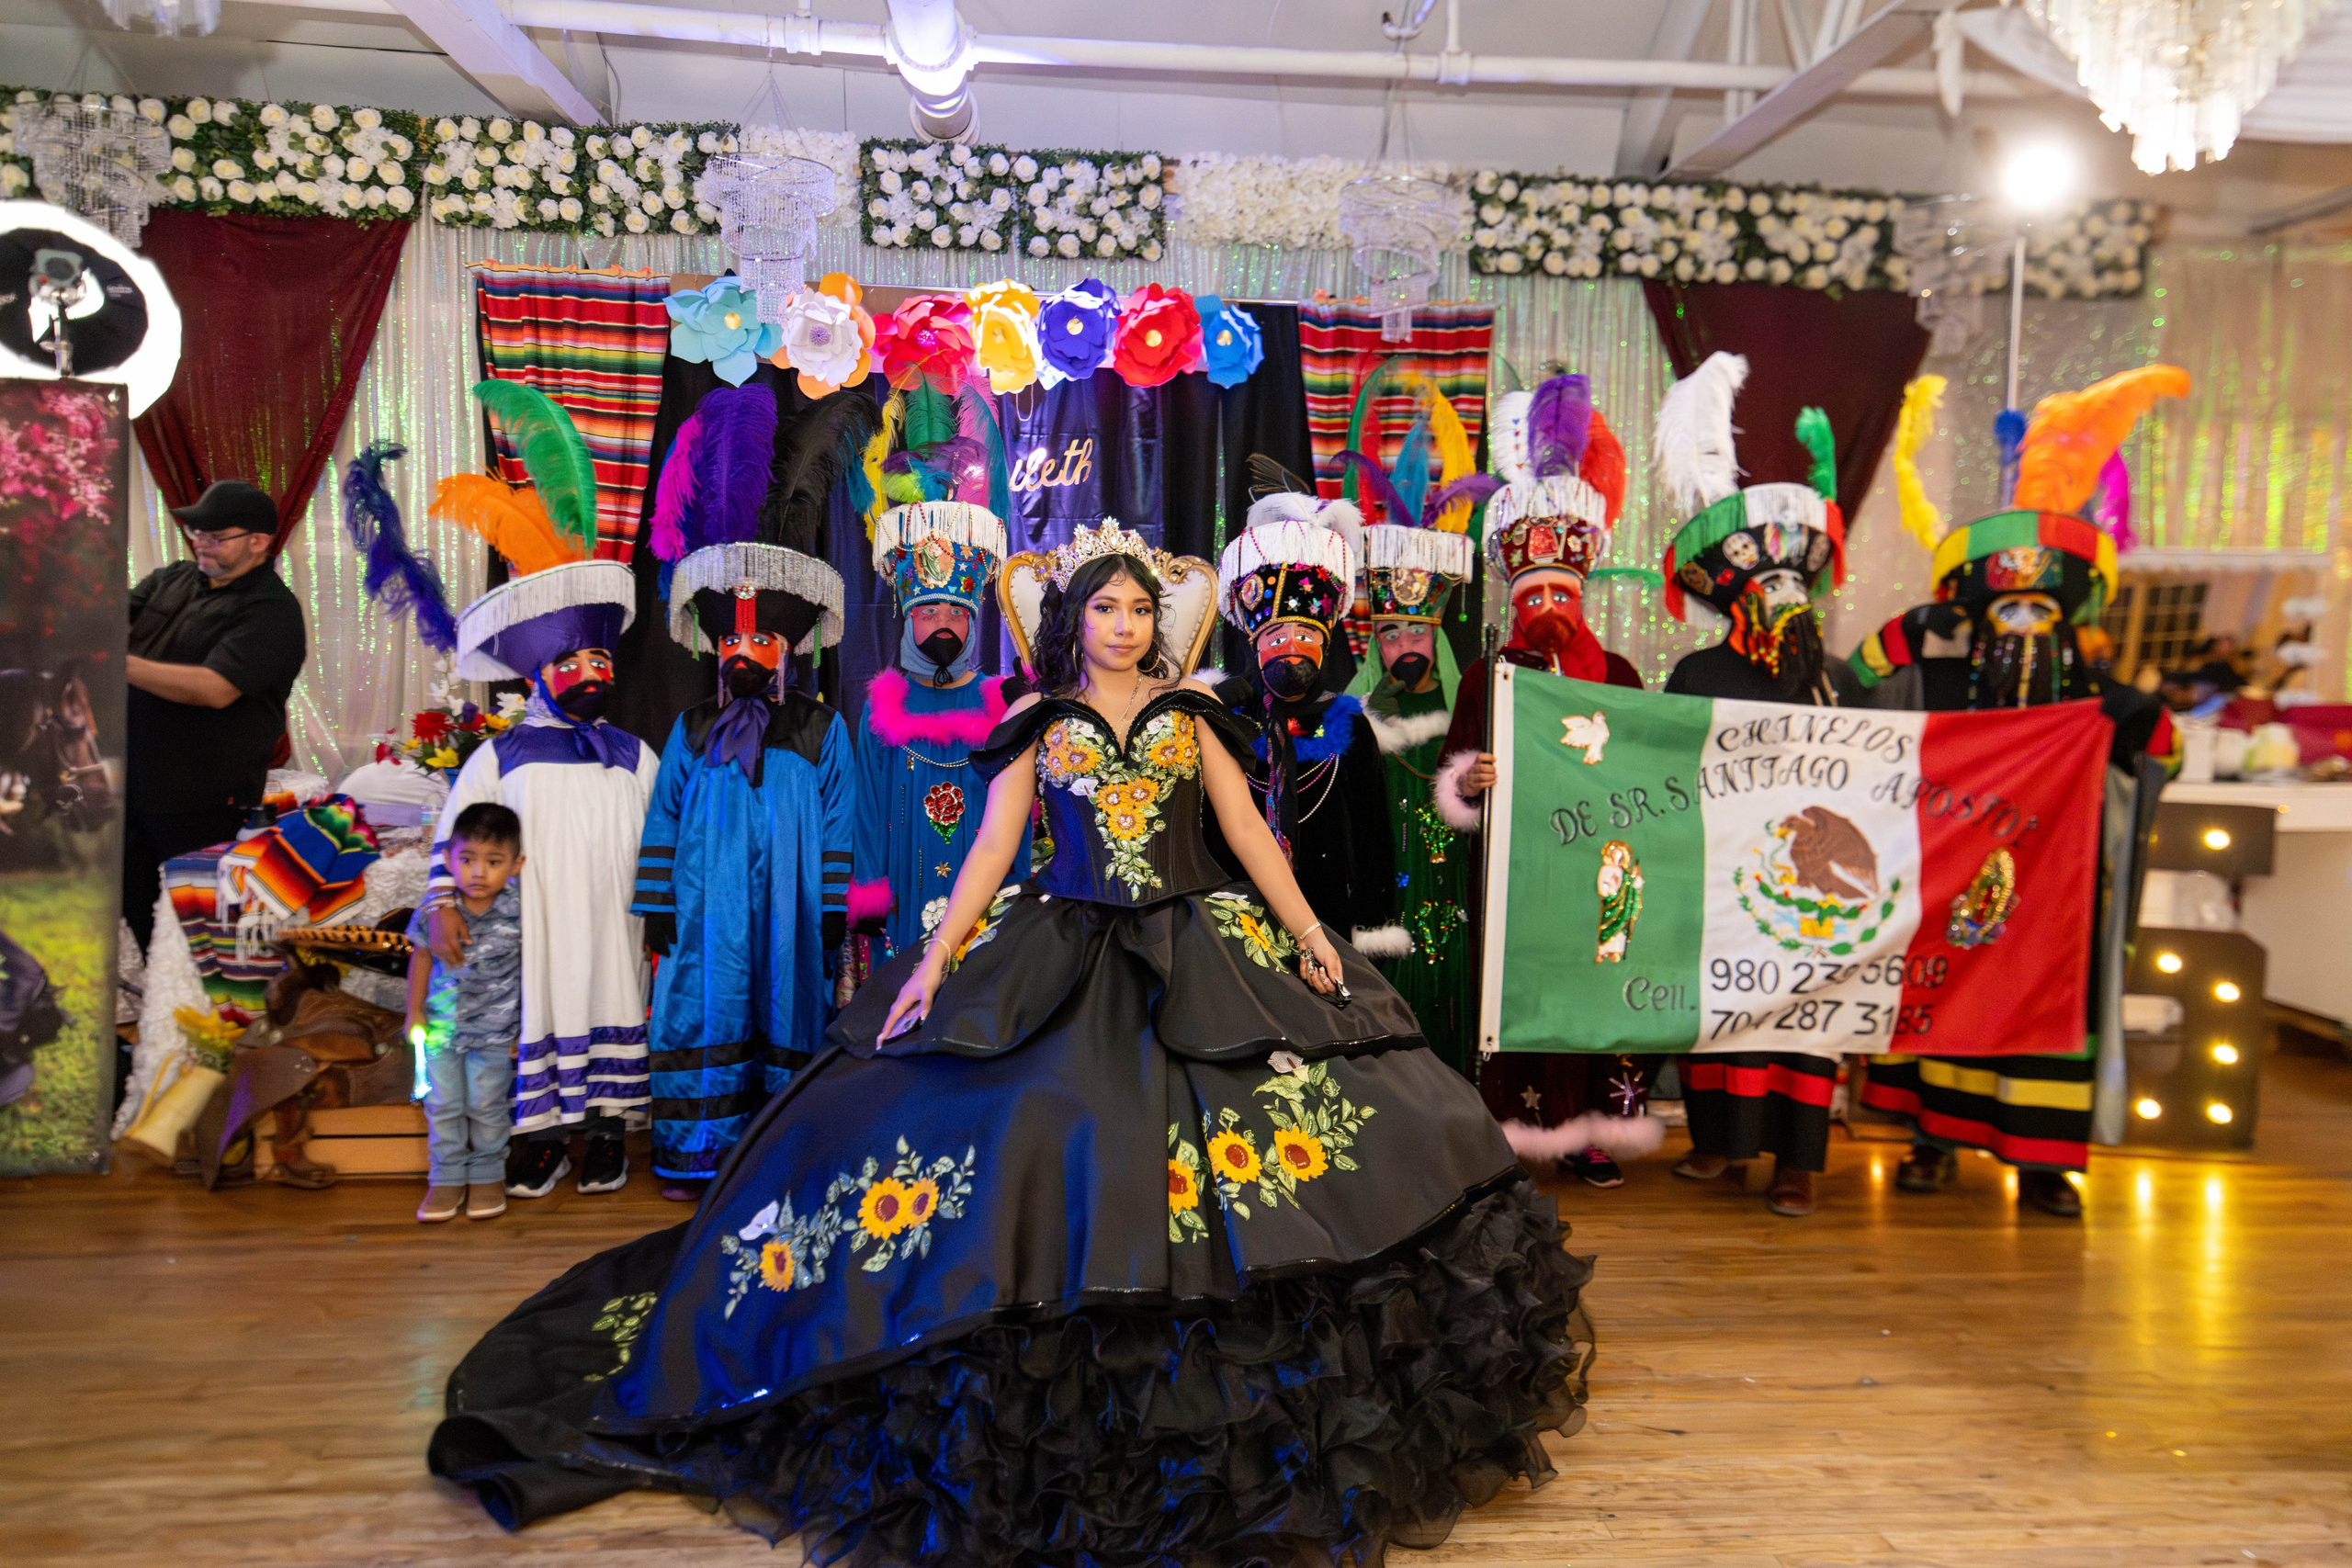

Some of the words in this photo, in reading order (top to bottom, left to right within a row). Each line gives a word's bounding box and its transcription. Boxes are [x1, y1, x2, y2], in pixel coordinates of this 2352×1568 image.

[1716, 714, 1913, 763] CHINELOS
[1549, 801, 1598, 845] DE
[1610, 787, 1665, 828] SR.
[1665, 755, 1849, 811] SANTIAGO
[1711, 958, 1780, 994] 980
[1774, 999, 1843, 1032] 287
